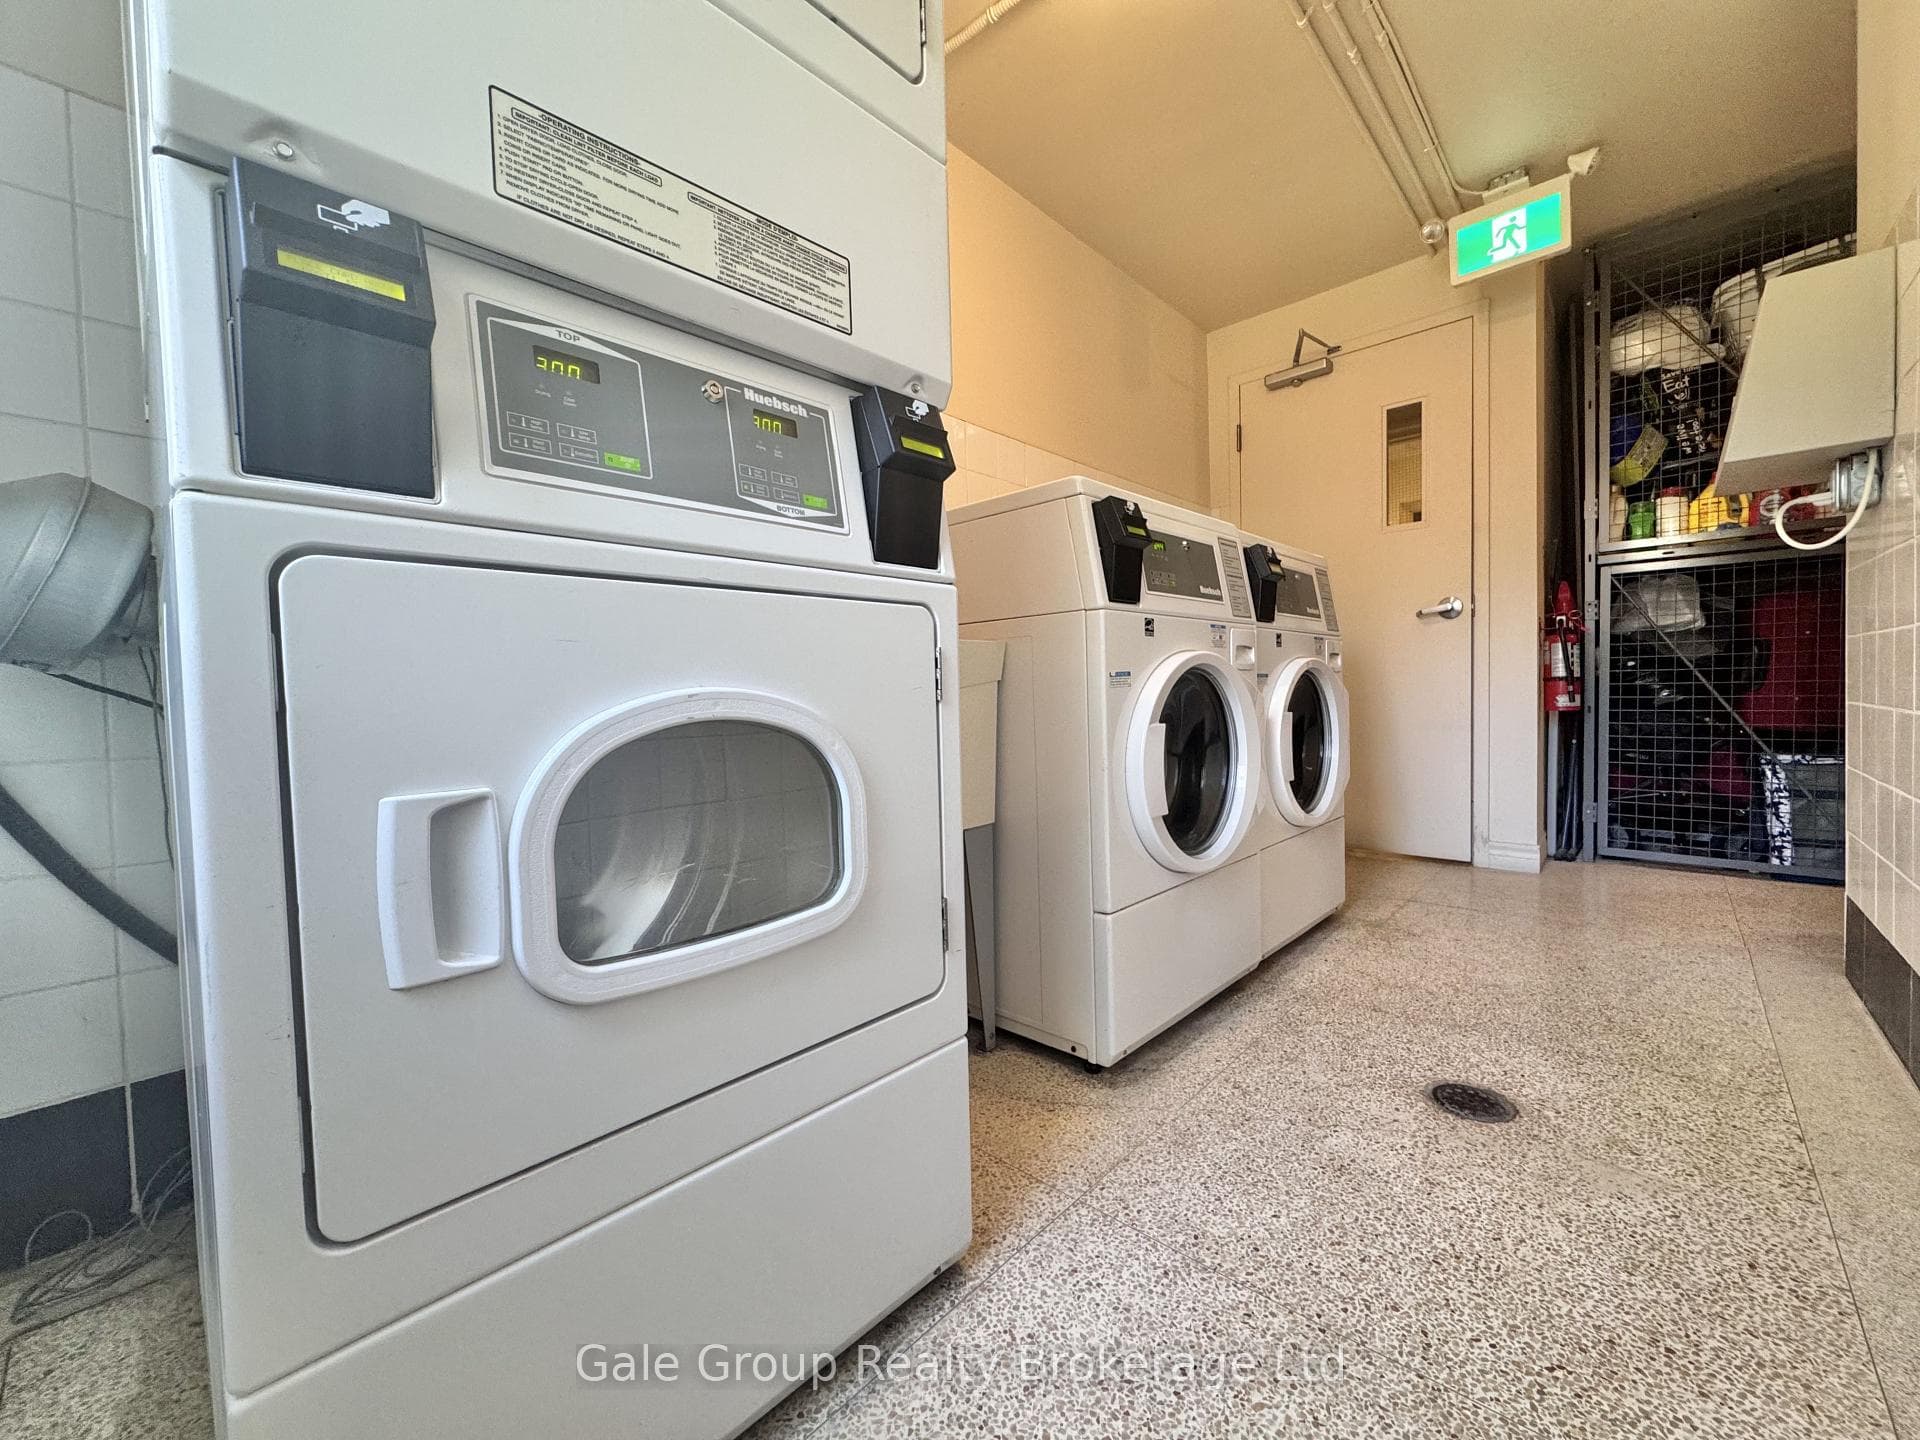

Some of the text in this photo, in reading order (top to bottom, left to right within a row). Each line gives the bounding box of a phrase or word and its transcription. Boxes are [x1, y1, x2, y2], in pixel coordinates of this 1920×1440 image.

[552, 129, 572, 142] CLEAN
[573, 139, 585, 149] LINT
[587, 145, 605, 158] FILTER
[607, 154, 628, 168] BEFORE
[629, 165, 643, 176] EACH
[555, 329, 580, 342] TOP
[1662, 375, 1690, 393] Eat
[743, 387, 809, 418] Huebsch
[776, 505, 805, 516] BOTTOM
